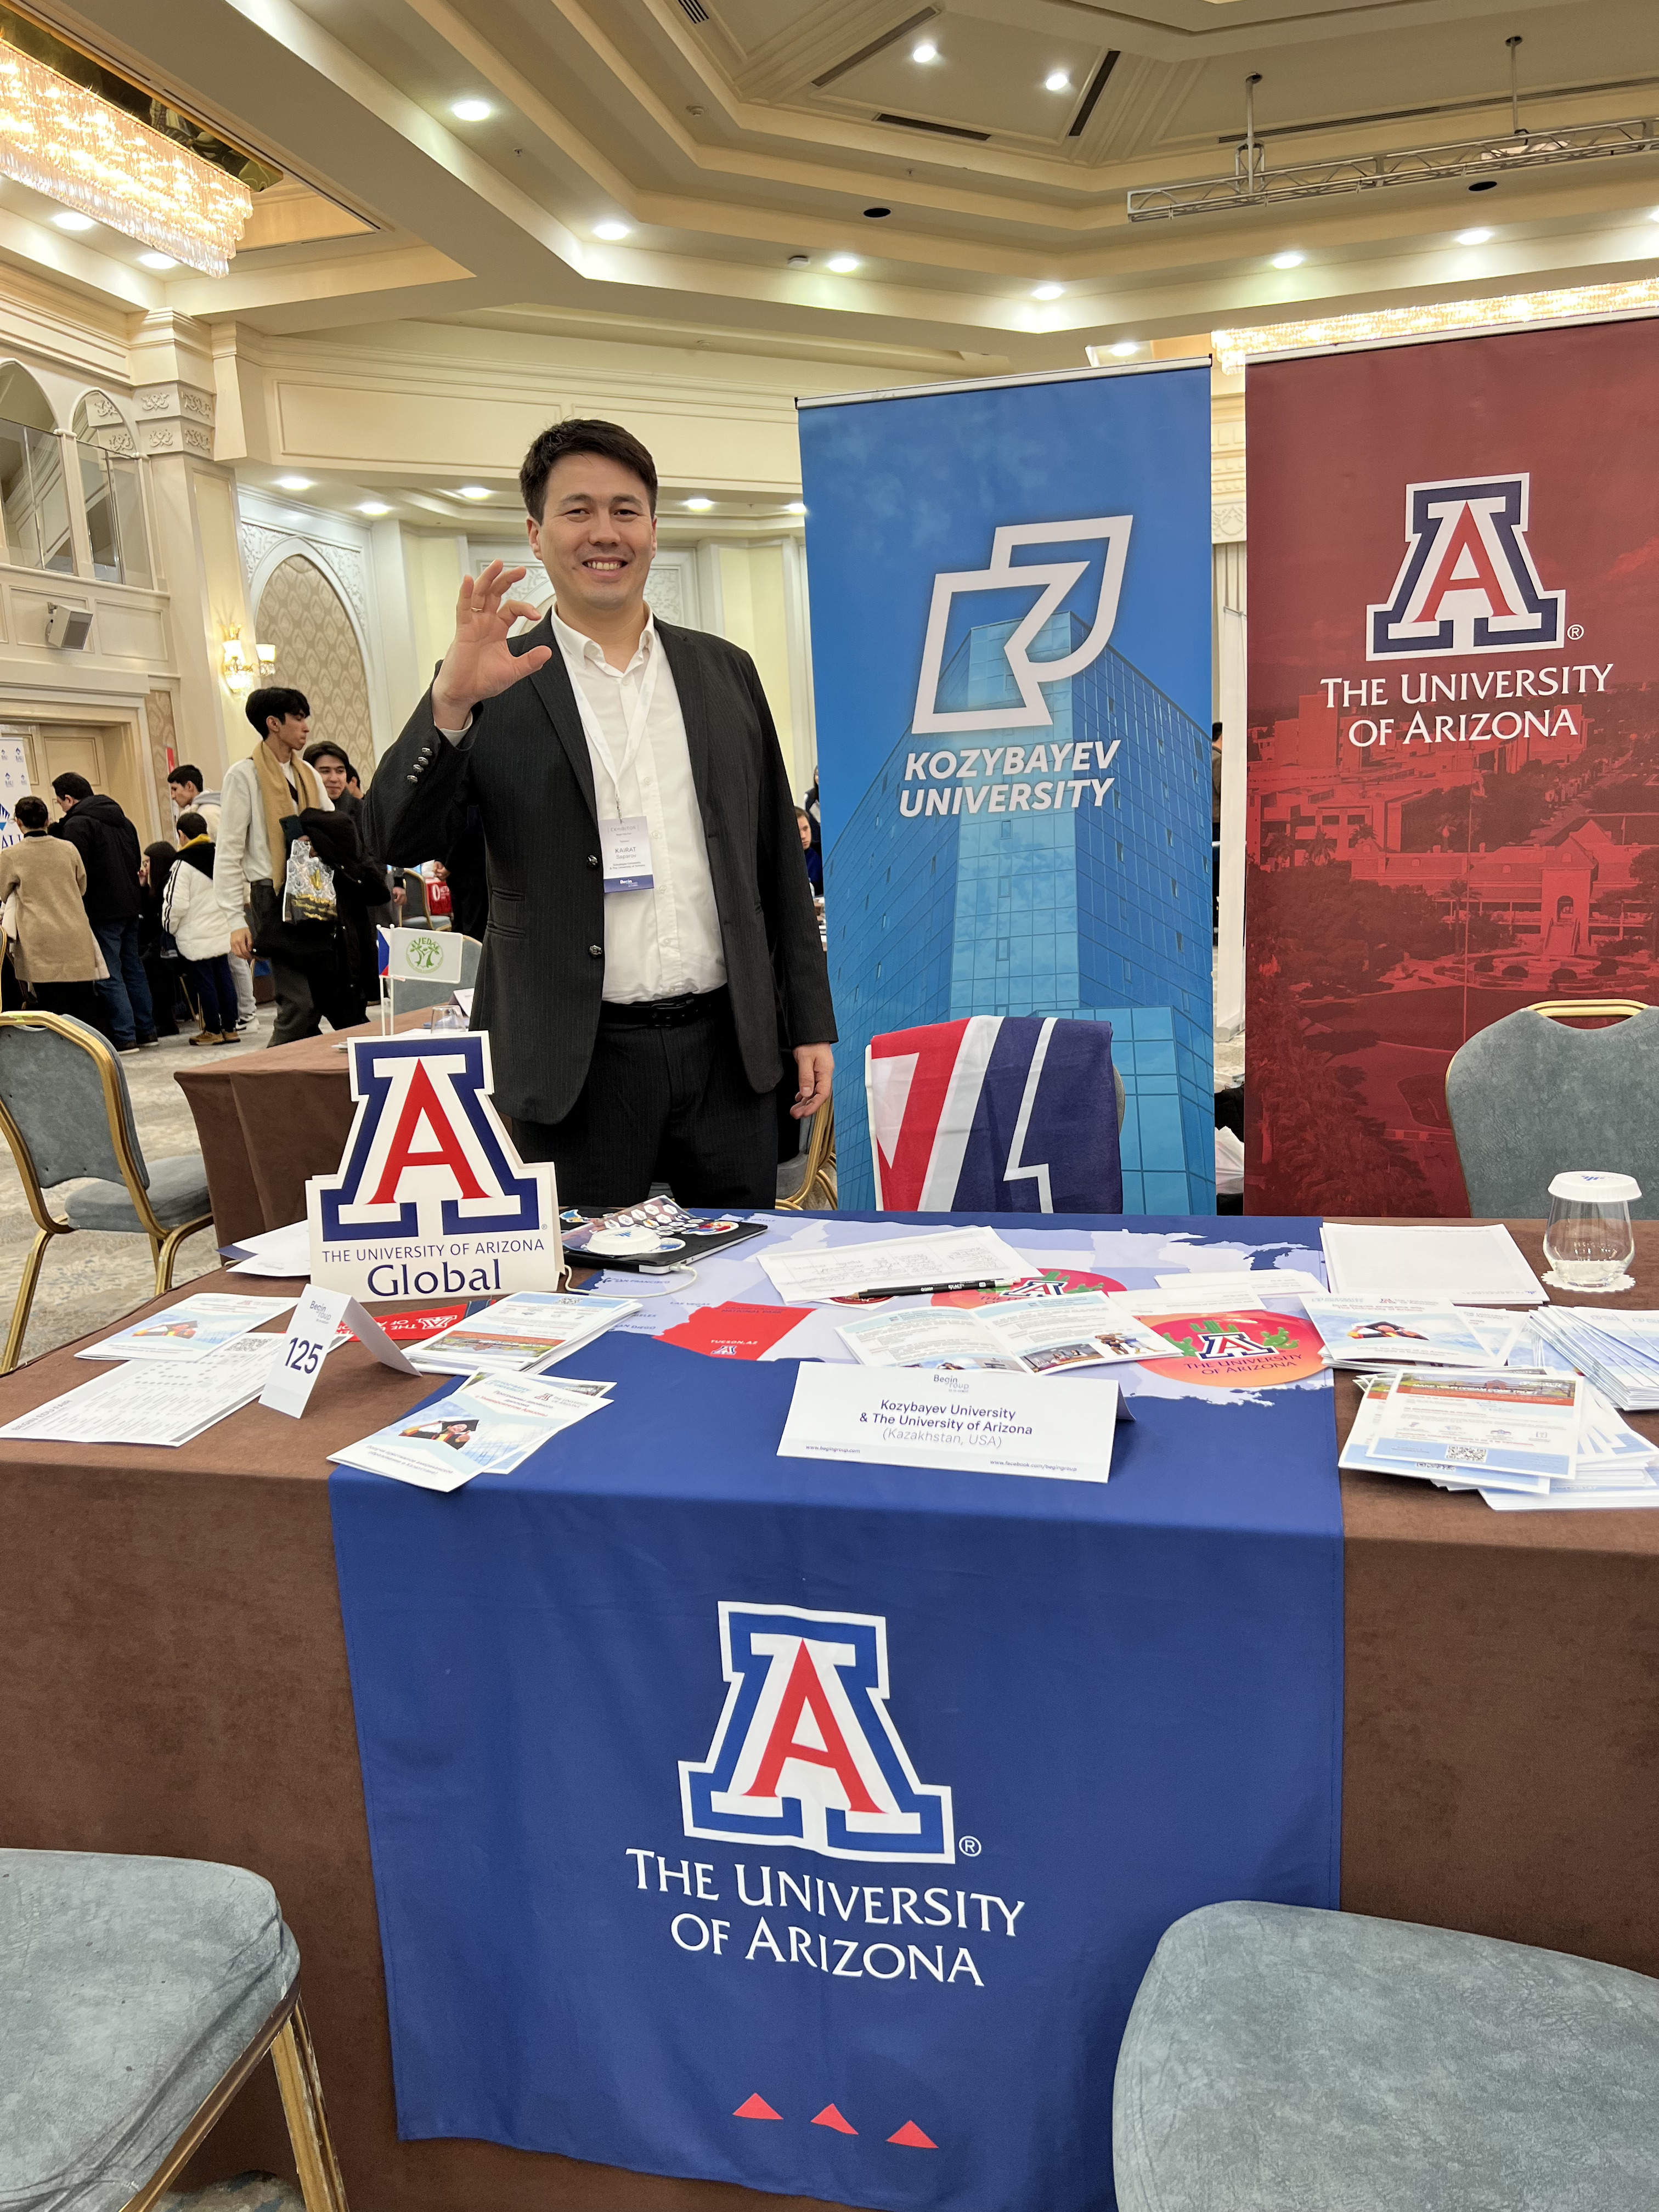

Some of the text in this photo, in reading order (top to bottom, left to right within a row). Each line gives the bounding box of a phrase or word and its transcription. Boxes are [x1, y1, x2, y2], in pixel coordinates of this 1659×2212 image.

[1320, 663, 1613, 708] THE UNIVERSITY
[1348, 708, 1578, 747] OF ARIZONA
[904, 740, 1121, 781] KOZYBAYEV
[899, 777, 1115, 817] UNIVERSITY
[322, 1239, 544, 1262] THE UNIVERSITY OF ARIZONA
[367, 1259, 502, 1296] Global
[284, 1337, 324, 1374] 125
[1217, 1354, 1302, 1367] UNIVERSITY
[1226, 1361, 1297, 1373] ARIZONA
[934, 1374, 958, 1385] Begin
[860, 1412, 1032, 1435] & The University of Arizona
[881, 1399, 1016, 1421] Kozybayev University
[883, 1427, 1002, 1449] (Kazakhstan, USA)
[625, 1848, 1025, 1937] THE UNIVERSITY
[671, 1913, 985, 1987] OF ARIZONA
